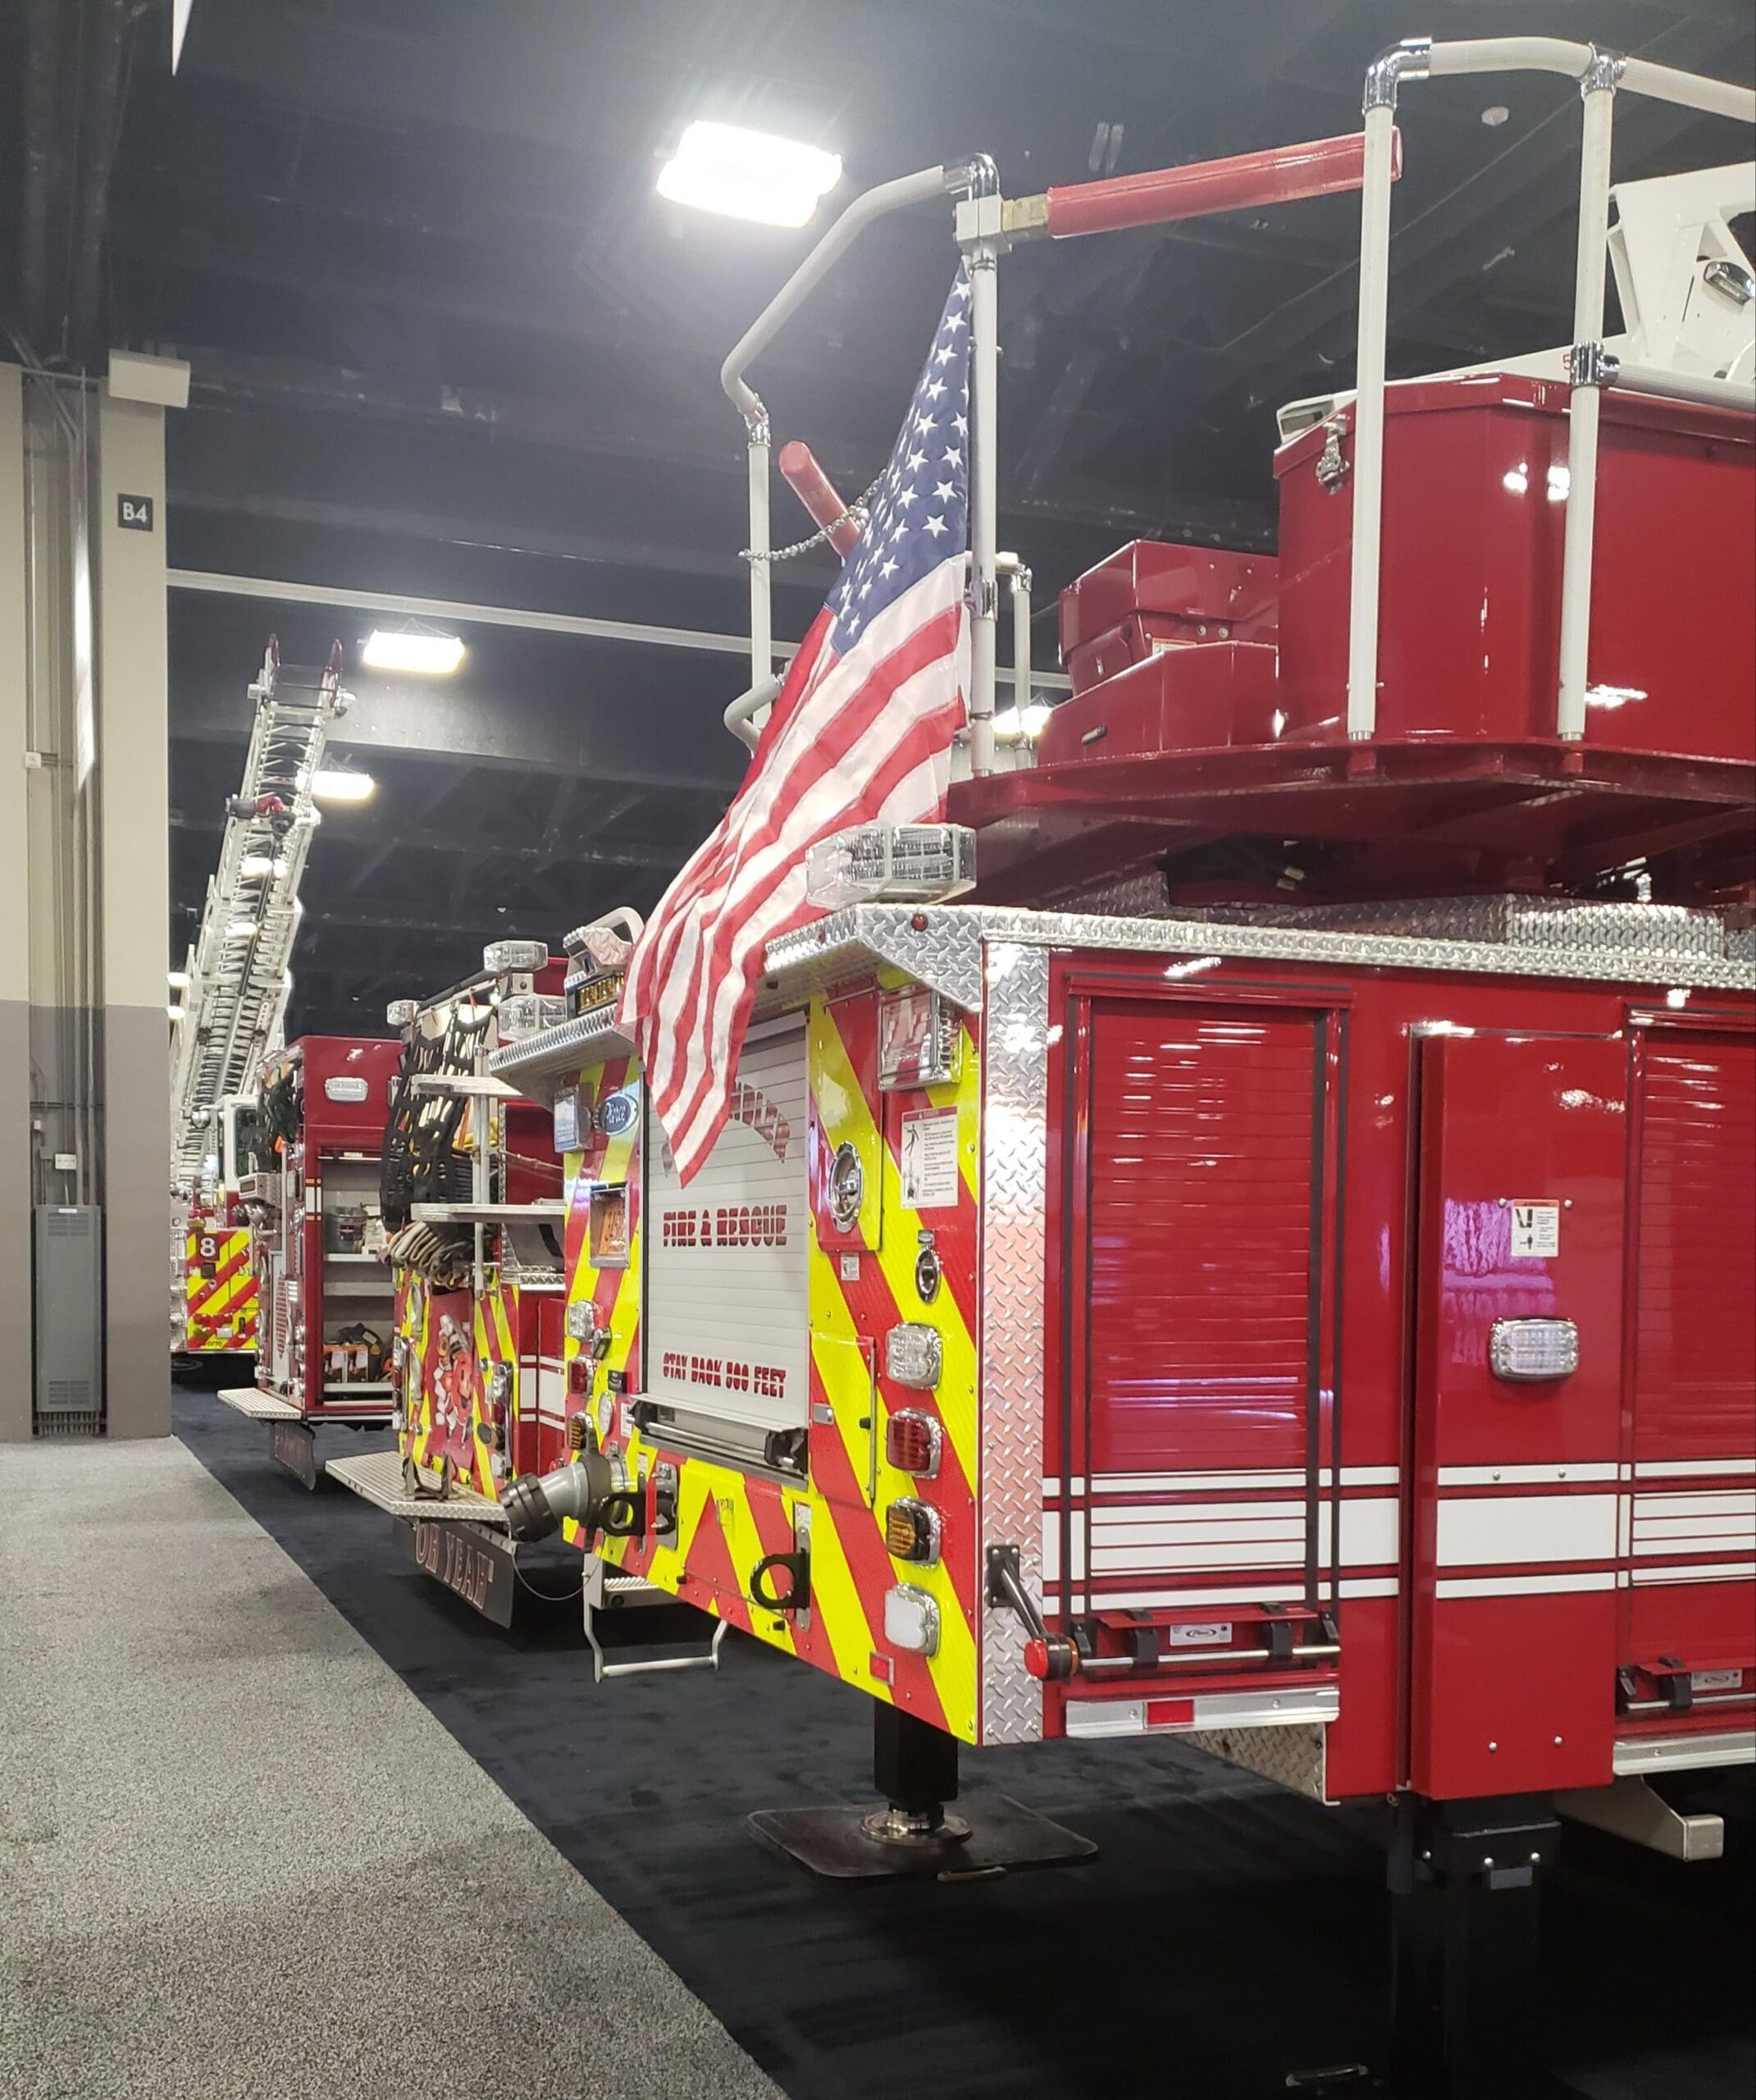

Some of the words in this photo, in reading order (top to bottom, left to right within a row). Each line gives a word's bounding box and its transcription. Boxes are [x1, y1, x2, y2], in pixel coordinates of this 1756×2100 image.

[123, 501, 148, 523] B4
[663, 1210, 696, 1247] FIRE
[717, 1204, 787, 1247] RESCUE
[199, 1237, 217, 1258] 8
[663, 1352, 688, 1381] STAY
[691, 1356, 723, 1387] BACK
[754, 1365, 787, 1399] FEET
